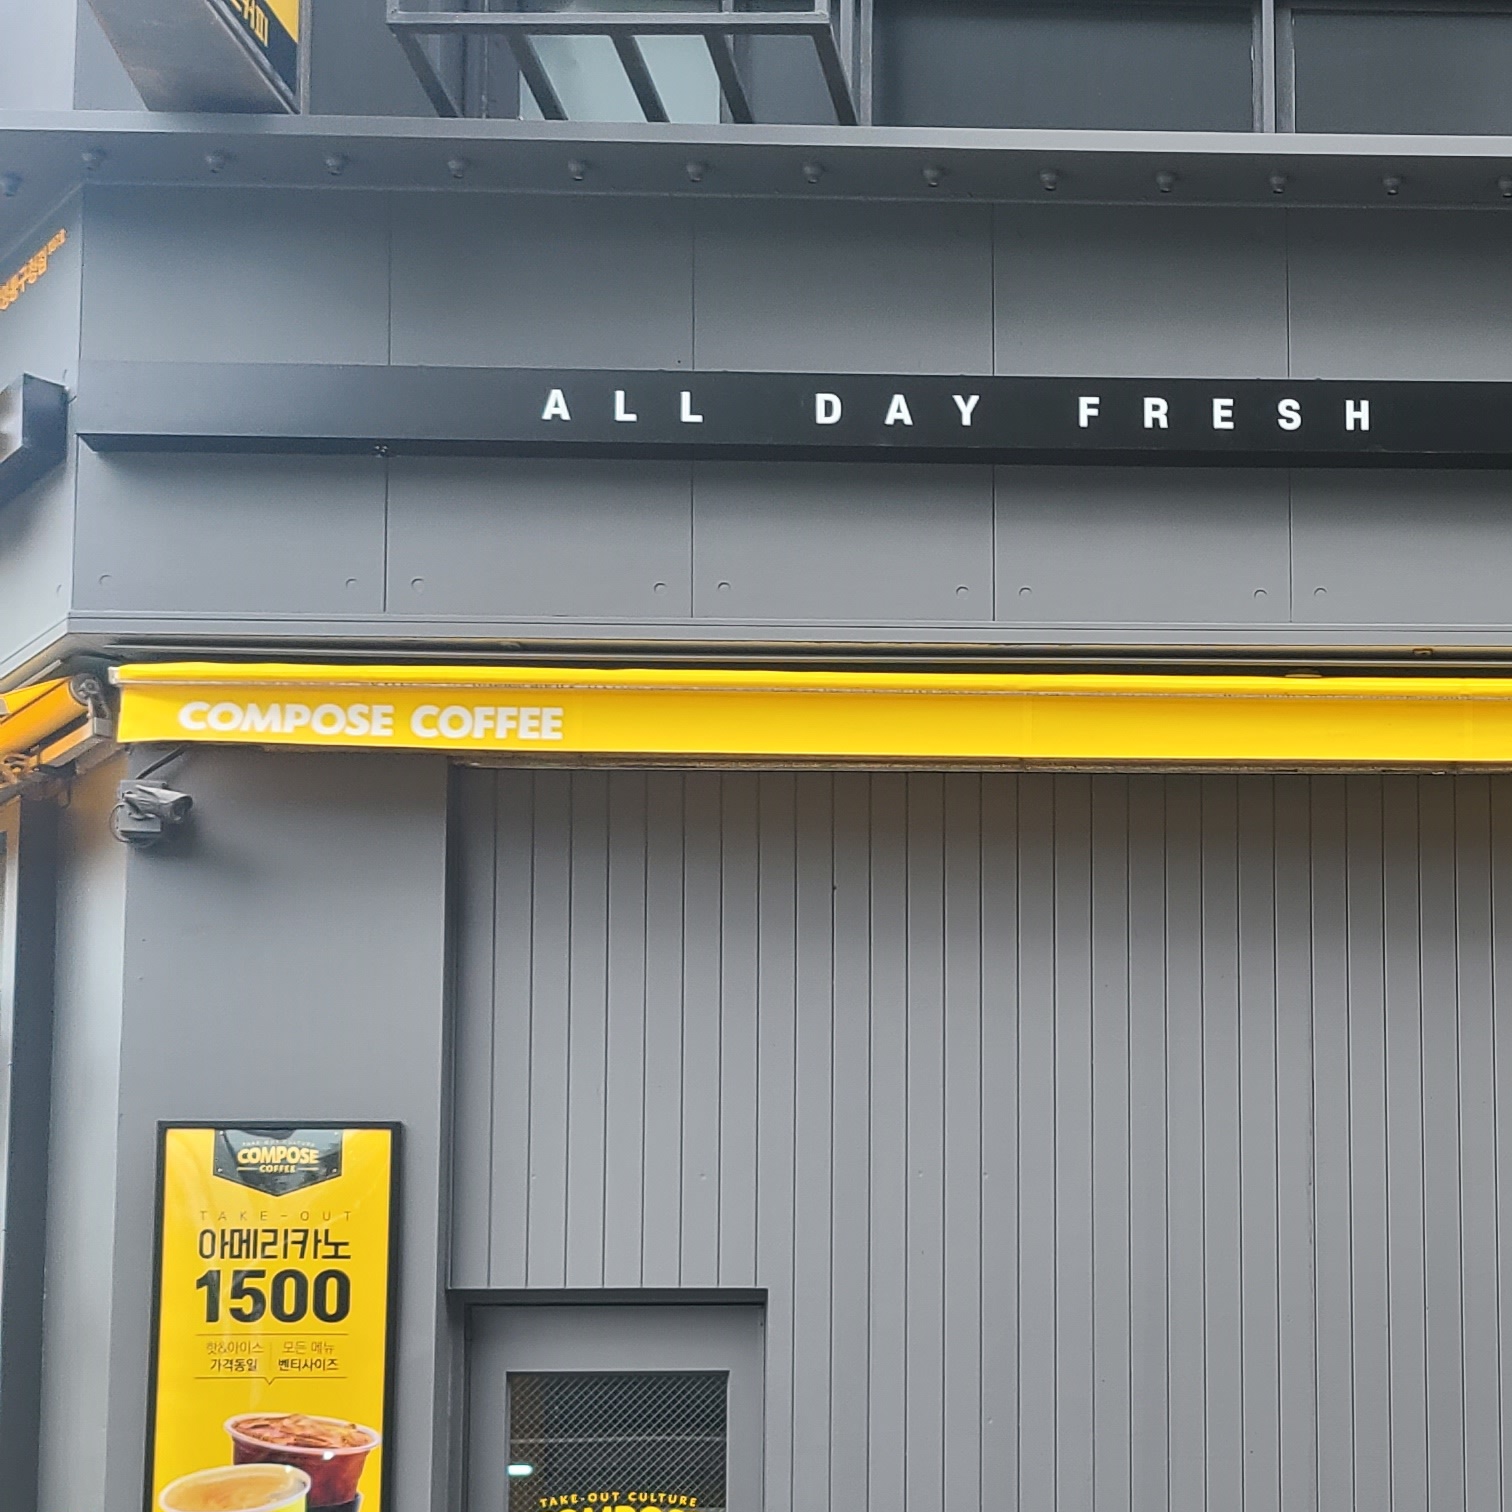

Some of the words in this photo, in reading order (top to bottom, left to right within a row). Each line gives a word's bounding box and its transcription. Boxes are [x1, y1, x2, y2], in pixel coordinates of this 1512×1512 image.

[541, 388, 704, 423] ALL
[815, 392, 980, 426] DAY
[1078, 396, 1370, 431] FRESH
[178, 701, 394, 737] COMPOSE
[411, 704, 563, 740] COFFEE
[237, 1146, 320, 1164] COMPOSE
[259, 1164, 297, 1173] COFFEE
[200, 1211, 352, 1221] TAKE-OUT
[198, 1228, 351, 1259] 아메리카노
[196, 1269, 350, 1323] 1500
[206, 1341, 264, 1355] 핫&아이스
[283, 1341, 307, 1355] 모든
[311, 1341, 335, 1355] 메뉴
[210, 1359, 258, 1372] 가격동일
[278, 1358, 339, 1372] 벤티사이즈
[539, 1492, 621, 1508] TAKE-OUT
[628, 1491, 698, 1508] CULTURE
